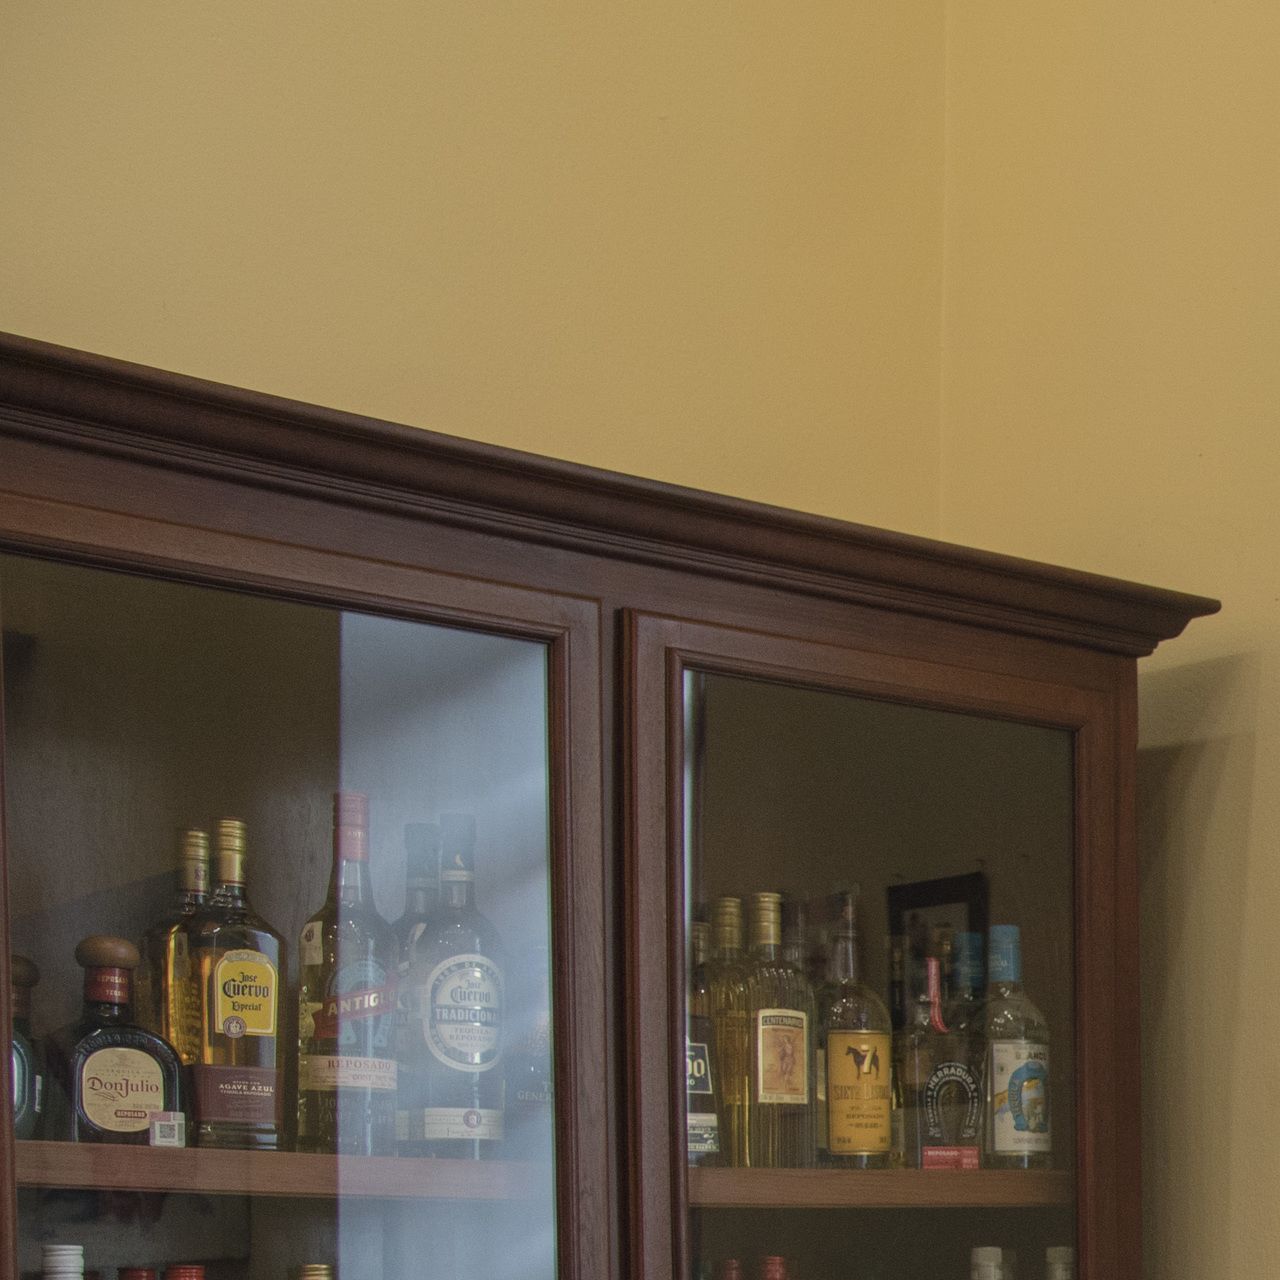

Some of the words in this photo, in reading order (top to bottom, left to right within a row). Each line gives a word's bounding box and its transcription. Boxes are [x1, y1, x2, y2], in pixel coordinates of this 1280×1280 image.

[240, 972, 258, 982] Jose
[222, 979, 269, 998] Cuervo
[232, 1001, 262, 1012] Especial
